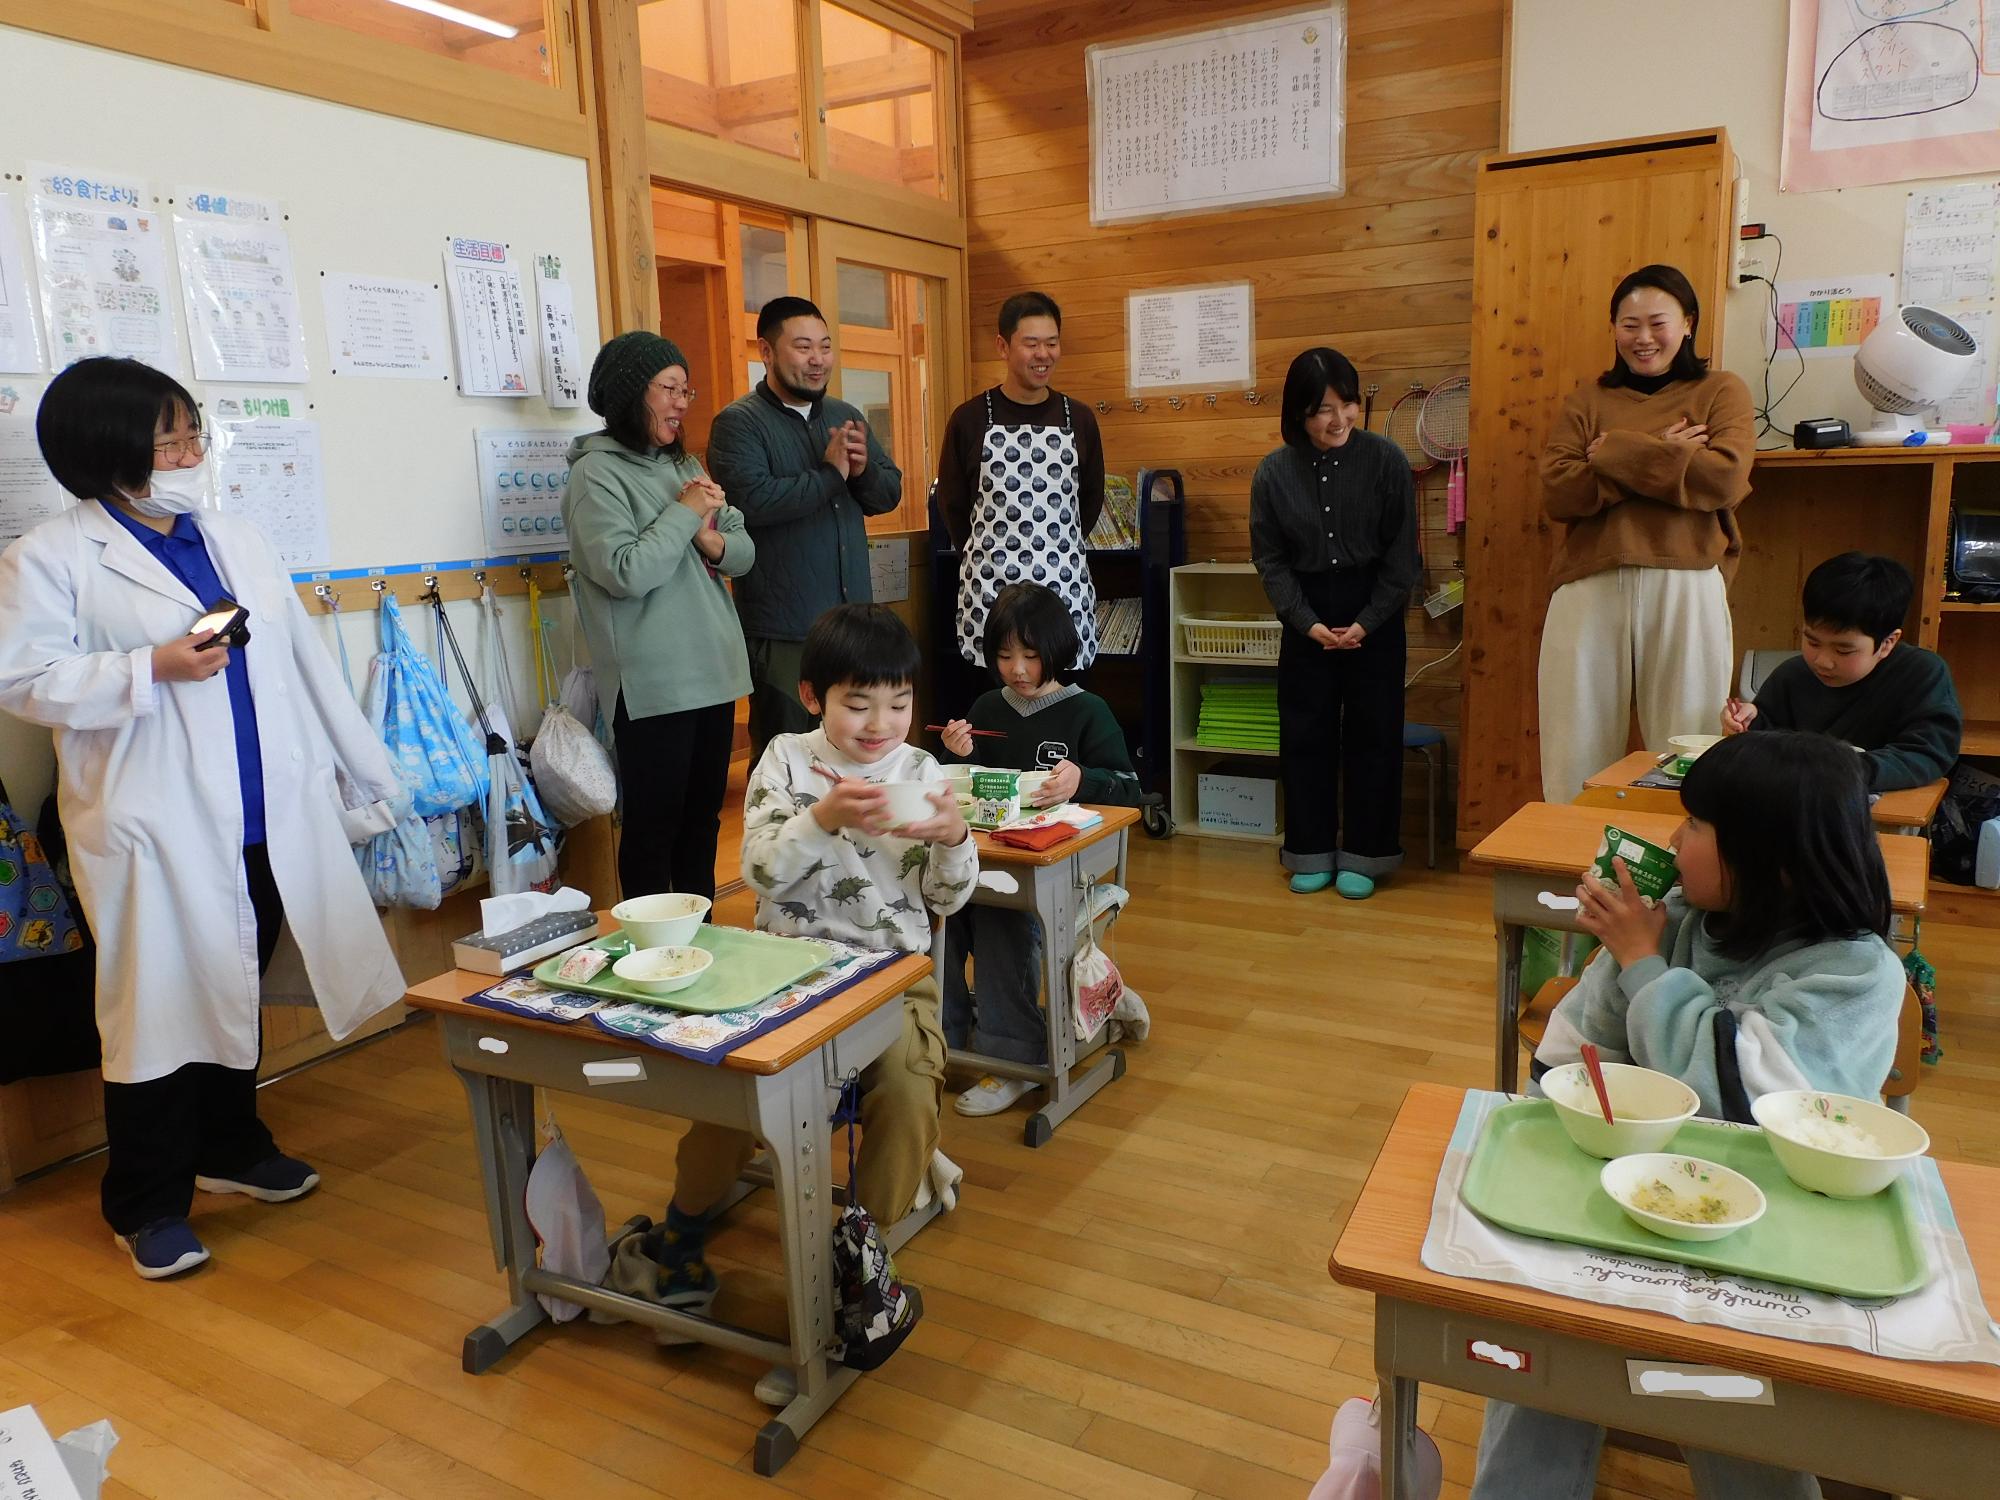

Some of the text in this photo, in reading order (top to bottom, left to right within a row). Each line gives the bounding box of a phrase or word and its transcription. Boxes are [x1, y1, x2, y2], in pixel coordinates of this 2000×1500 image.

[454, 238, 505, 263] 生活目標
[1582, 1264, 1812, 1320] Sumikkogurashi
